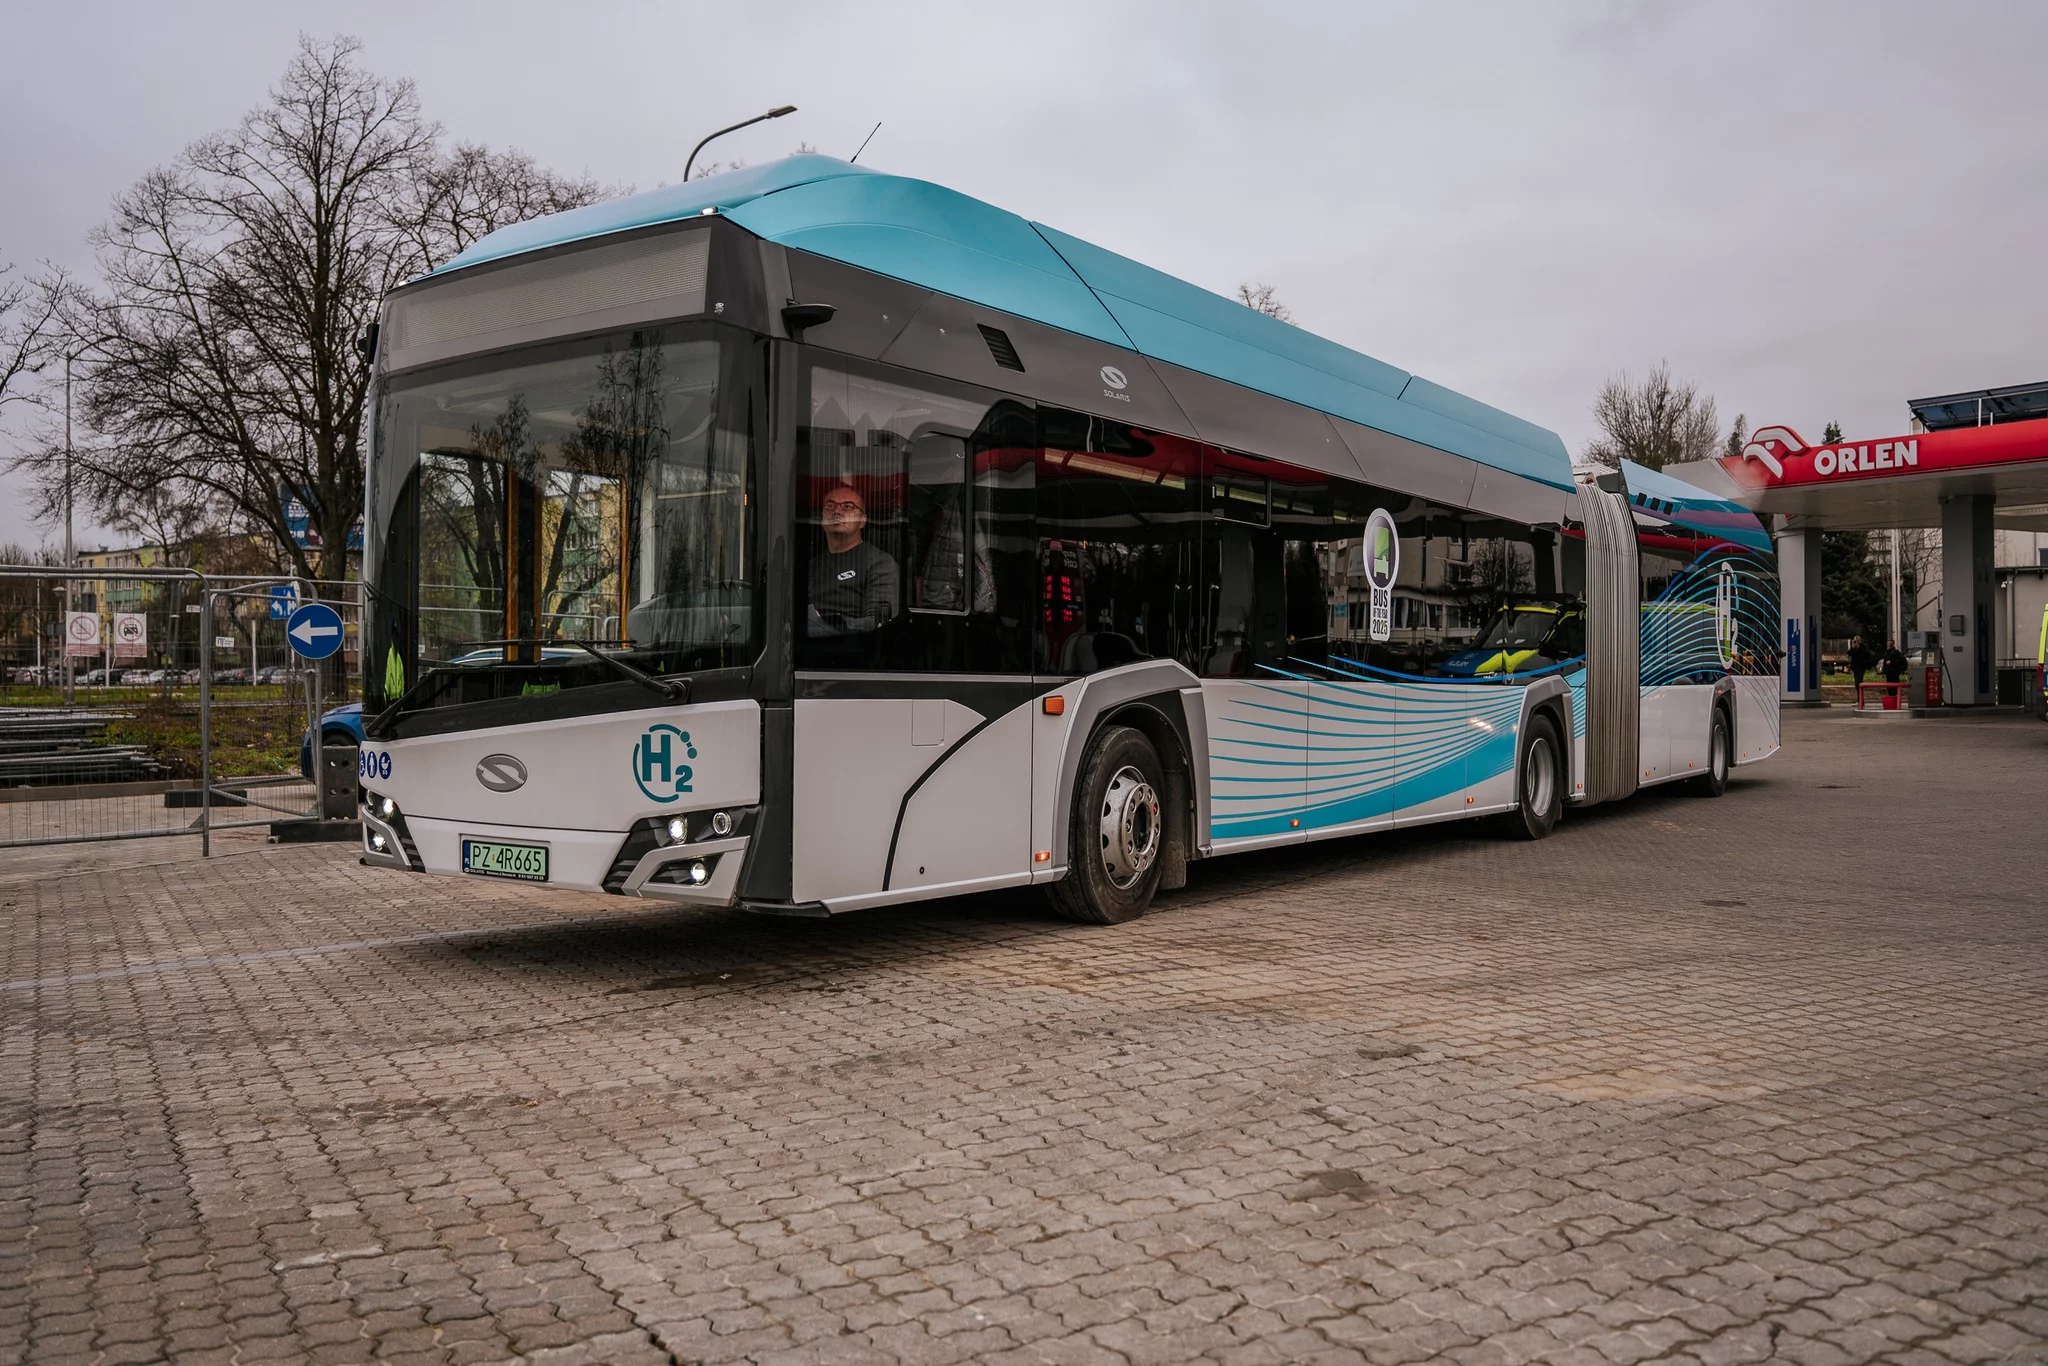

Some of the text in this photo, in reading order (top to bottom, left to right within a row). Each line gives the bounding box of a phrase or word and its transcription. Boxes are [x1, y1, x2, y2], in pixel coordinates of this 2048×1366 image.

[1103, 389, 1131, 403] SOLARIS
[1814, 439, 1918, 476] ORLEN
[1373, 588, 1388, 608] BUS
[1372, 619, 1388, 635] 2025
[472, 845, 542, 873] PZ 4R665
